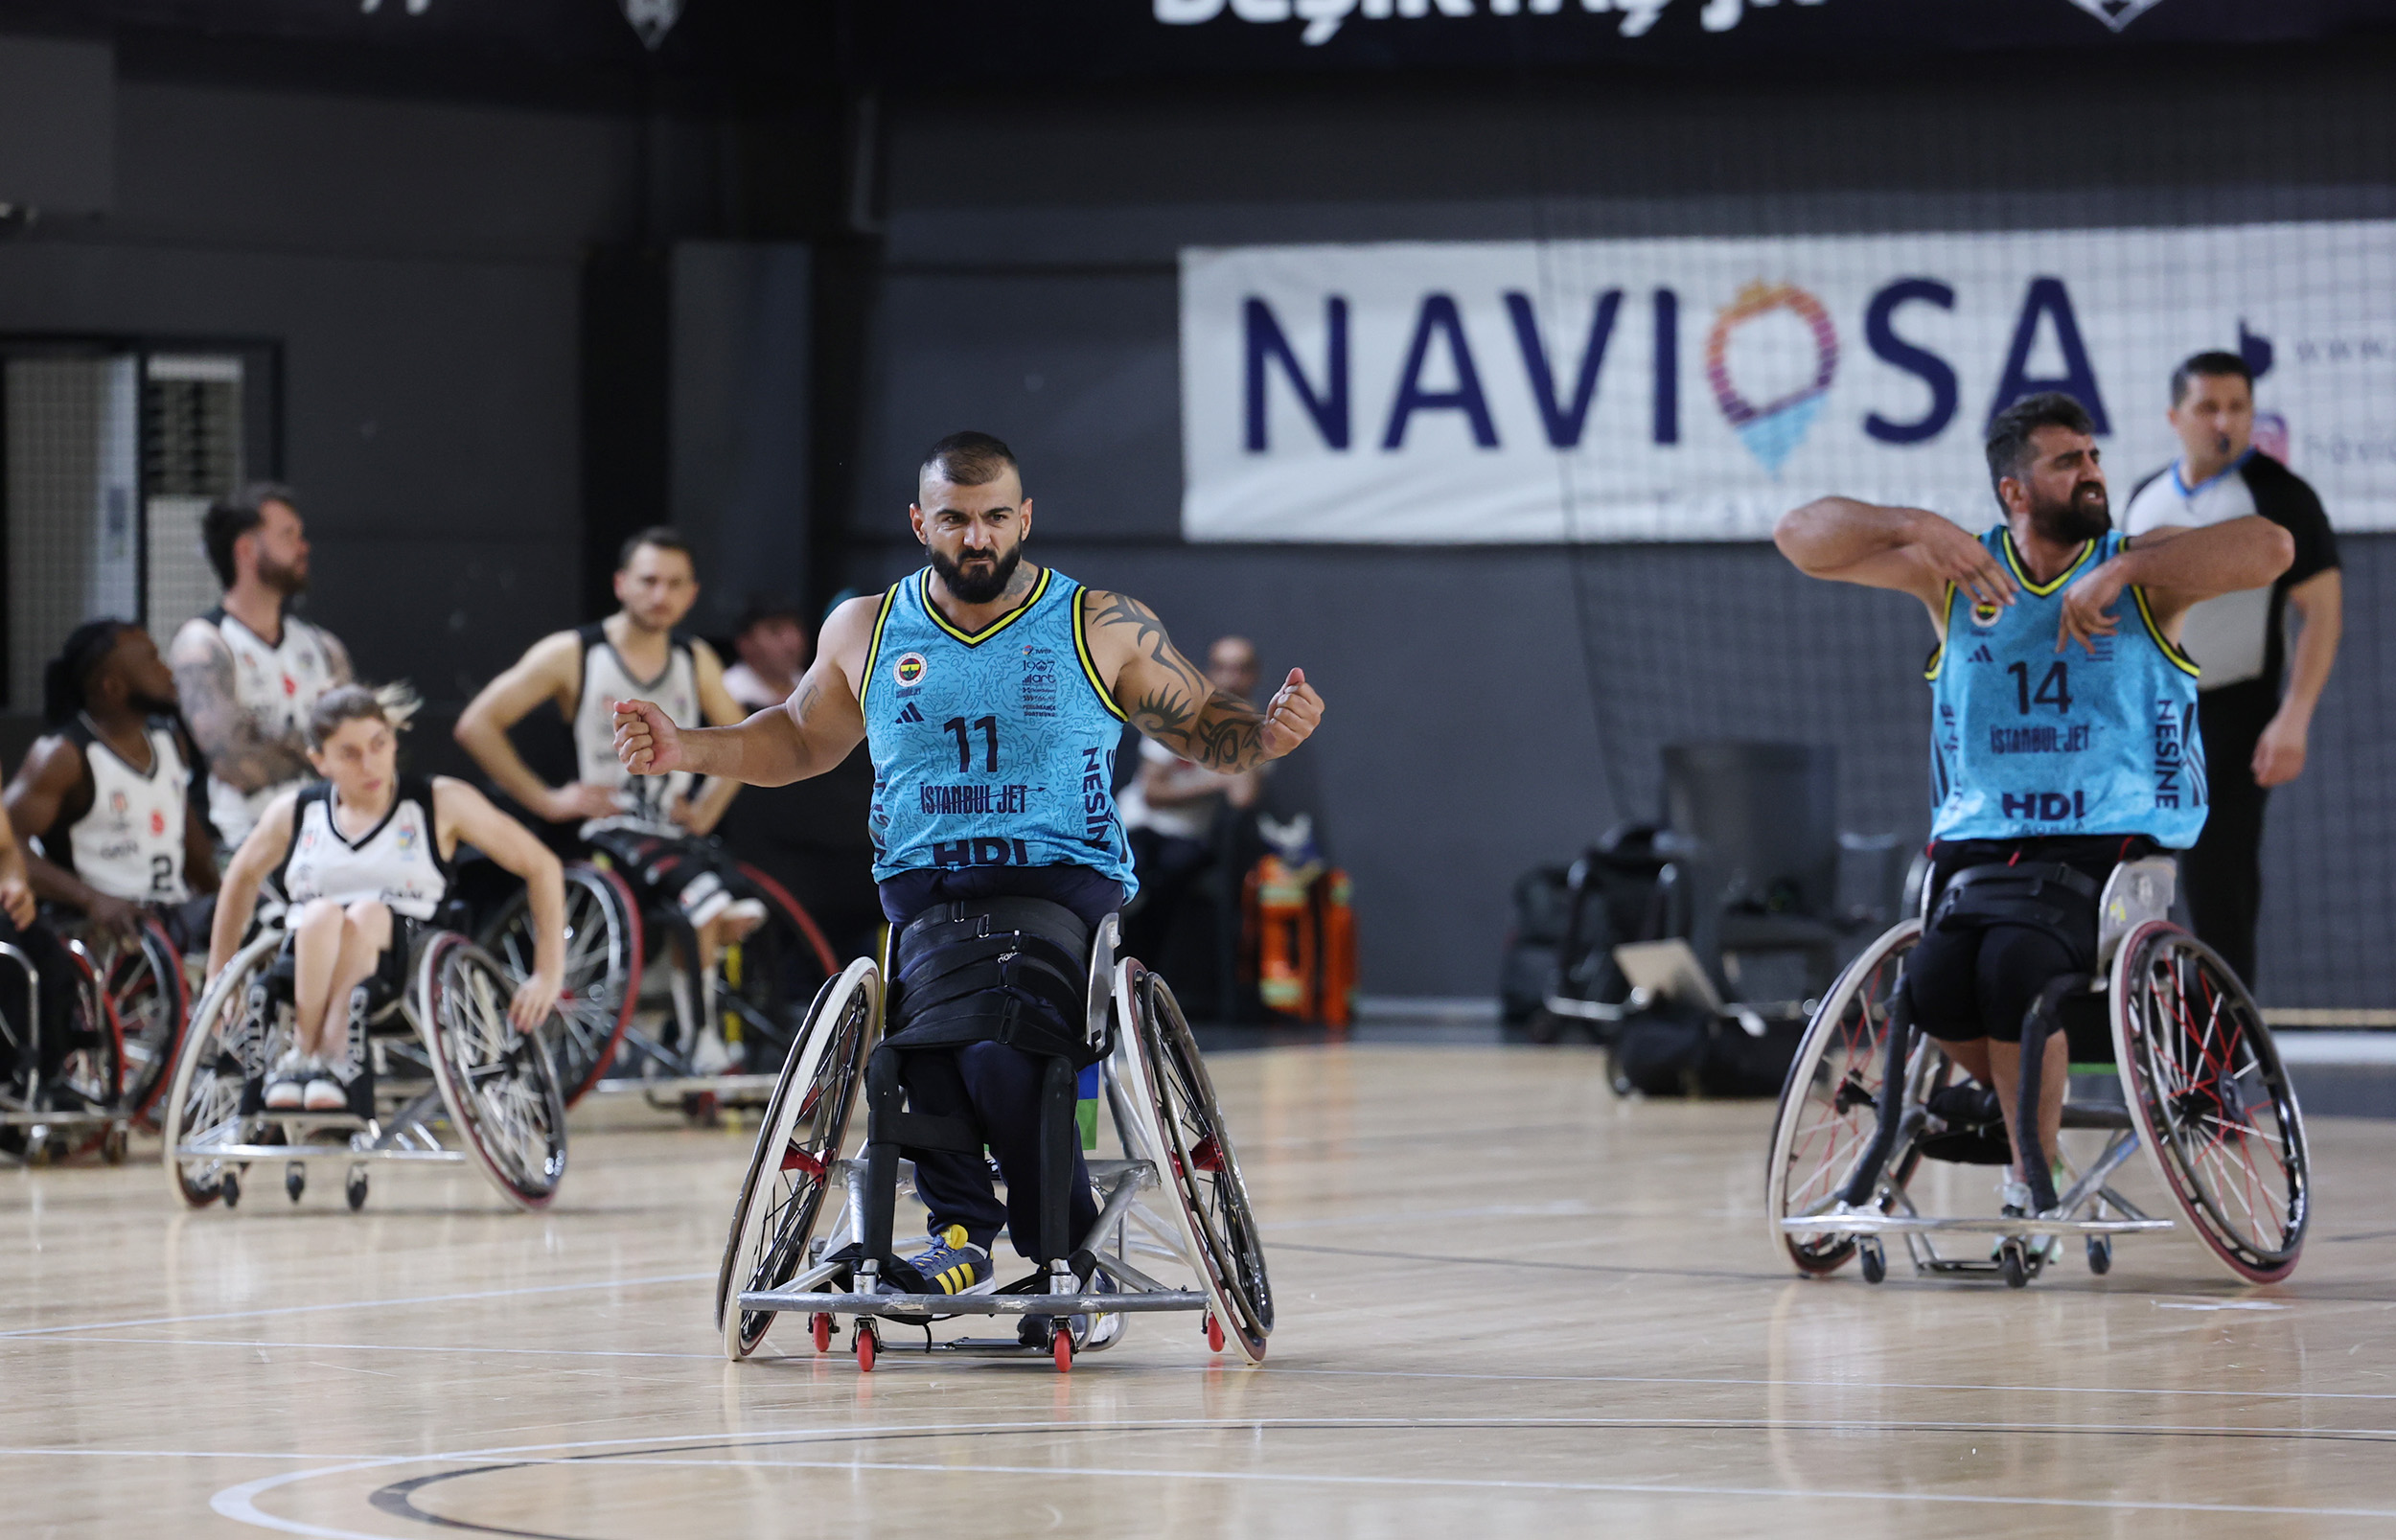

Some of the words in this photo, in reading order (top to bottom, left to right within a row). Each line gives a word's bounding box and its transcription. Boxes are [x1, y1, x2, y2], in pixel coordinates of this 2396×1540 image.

[1244, 275, 2114, 471] NAVIOSA
[1022, 659, 1056, 673] 1907
[2007, 661, 2073, 715] 14
[943, 716, 998, 773] 11
[997, 785, 1028, 814] JET
[2002, 790, 2086, 821] HDI
[933, 837, 1029, 866] HDI
[150, 854, 173, 892] 2
